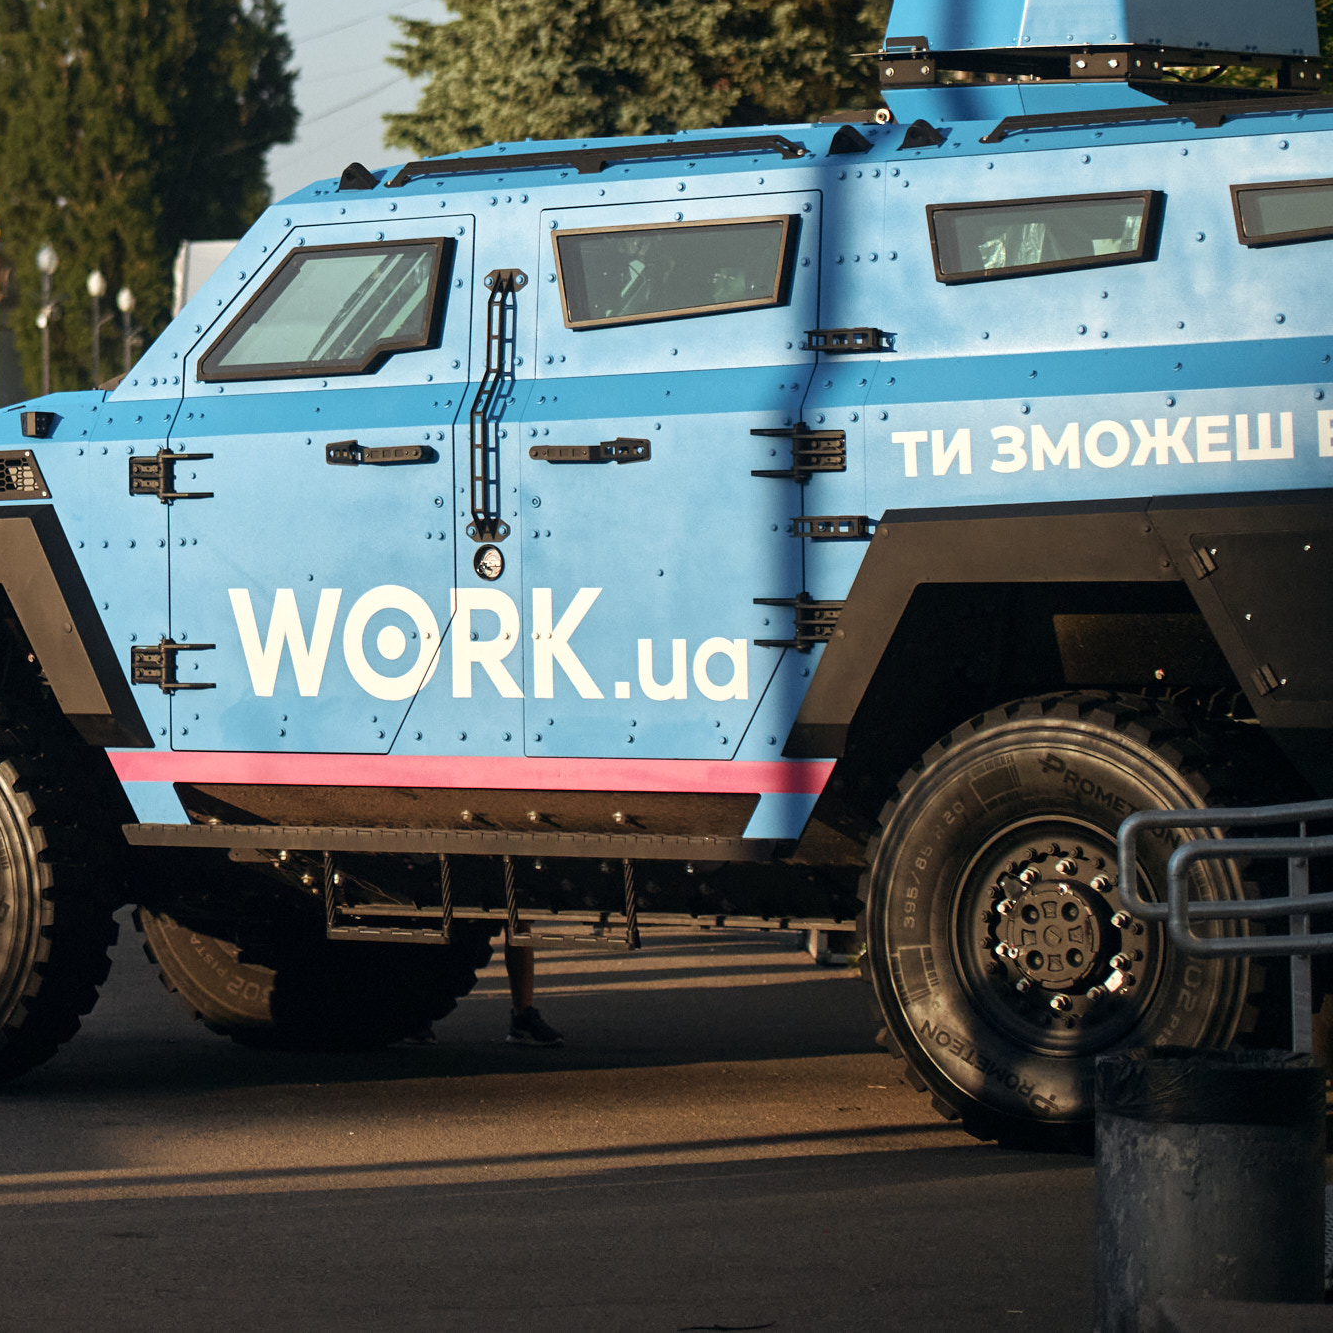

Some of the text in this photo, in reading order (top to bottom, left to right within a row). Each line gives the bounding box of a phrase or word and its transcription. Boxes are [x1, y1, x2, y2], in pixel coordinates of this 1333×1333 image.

[891, 428, 973, 478] ТИ
[990, 411, 1294, 474] ЗМОЖЕШ
[227, 584, 749, 702] WORK.ua
[1037, 752, 1182, 849] PROMETON
